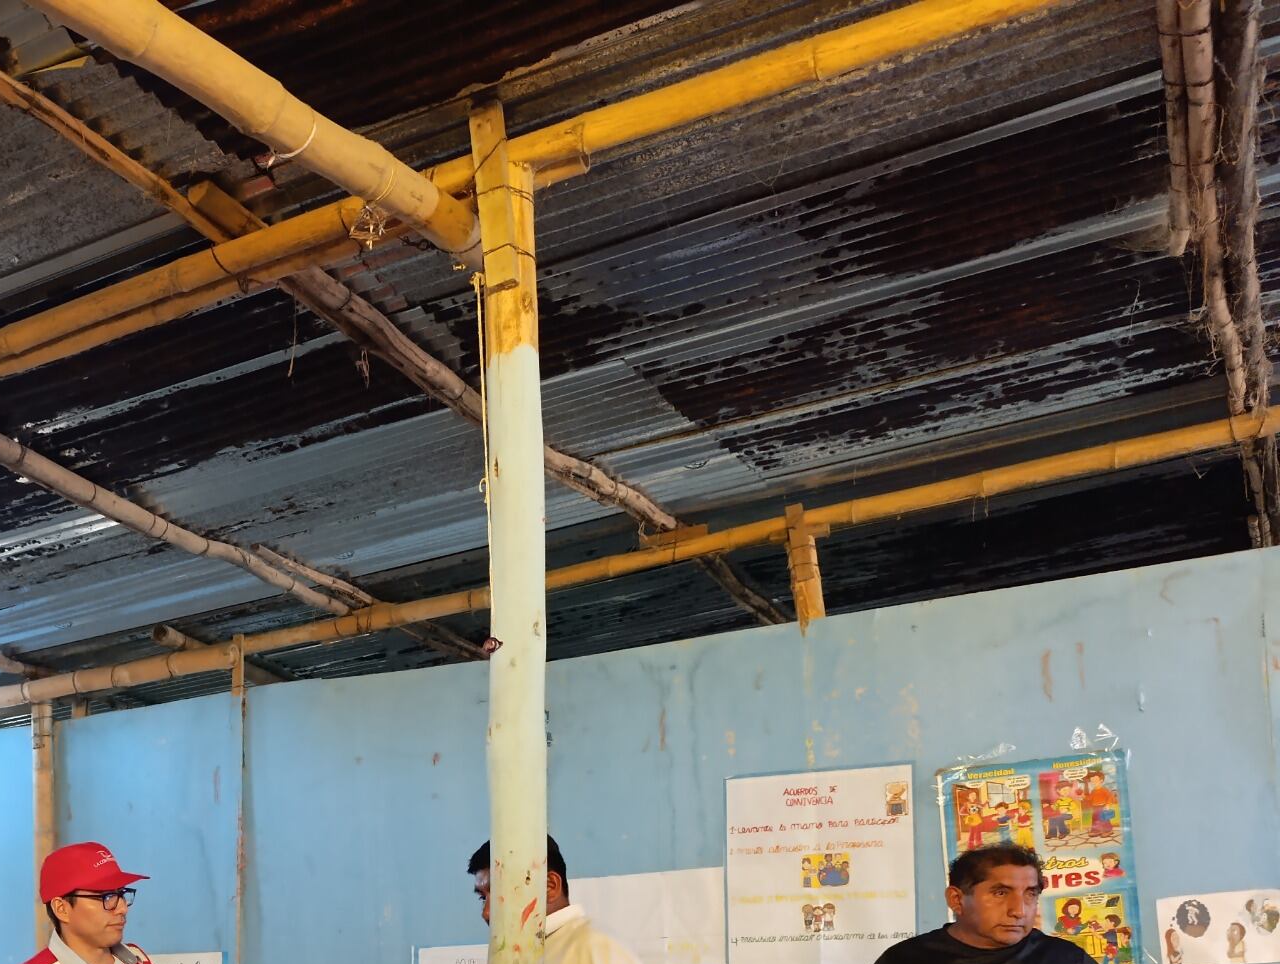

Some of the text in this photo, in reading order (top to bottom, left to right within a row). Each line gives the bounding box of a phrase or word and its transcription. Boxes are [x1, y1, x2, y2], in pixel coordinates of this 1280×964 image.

[968, 768, 1014, 780] Veracidad
[783, 786, 818, 796] ACUERDOS
[1043, 855, 1089, 870] tros
